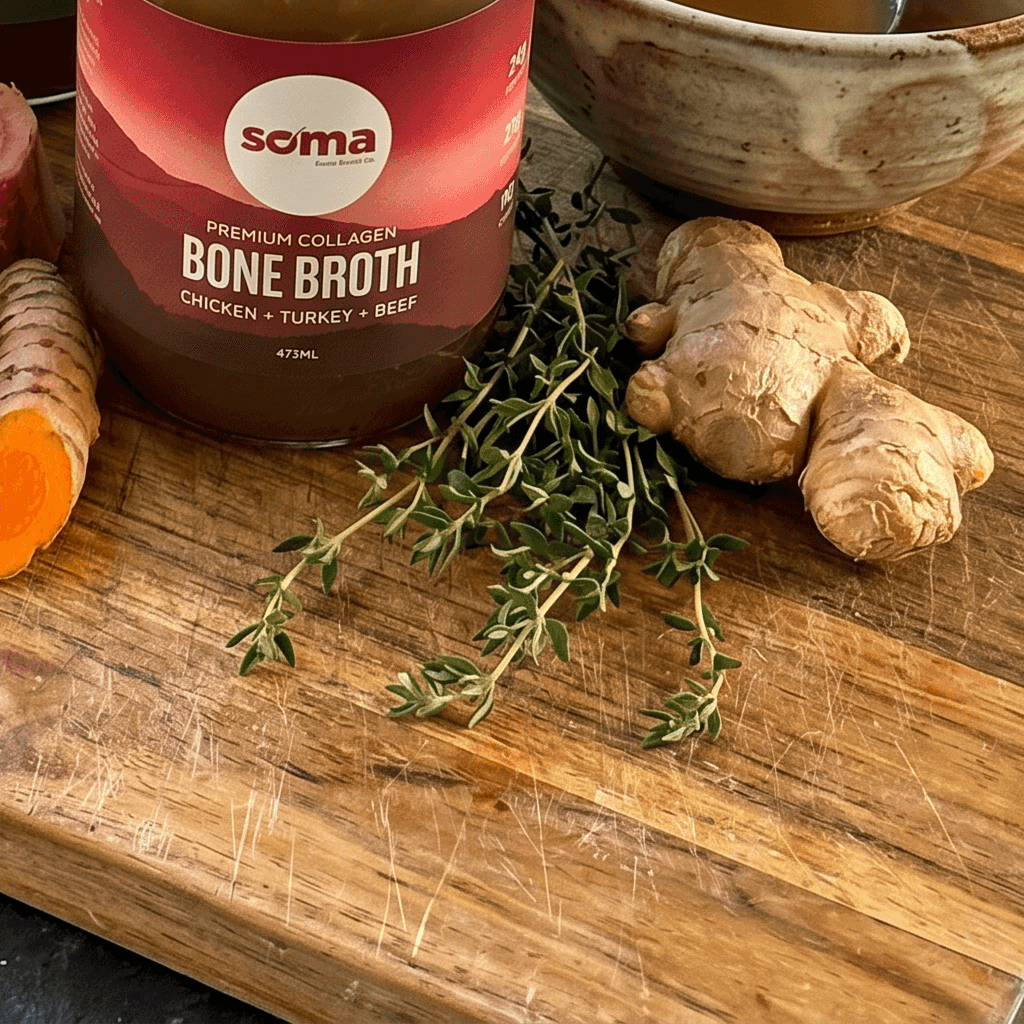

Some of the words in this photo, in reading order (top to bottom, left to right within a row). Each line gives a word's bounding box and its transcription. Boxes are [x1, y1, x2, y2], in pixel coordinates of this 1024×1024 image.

[241, 126, 376, 156] soma
[206, 220, 293, 246] PREMIUM
[298, 226, 397, 247] COLLAGEN
[182, 233, 284, 298] BONE
[294, 240, 420, 299] BROTH
[180, 289, 257, 321] CHICKEN
[279, 309, 354, 325] TURKEY
[374, 295, 418, 318] BEEF
[276, 348, 319, 360] 473ML
